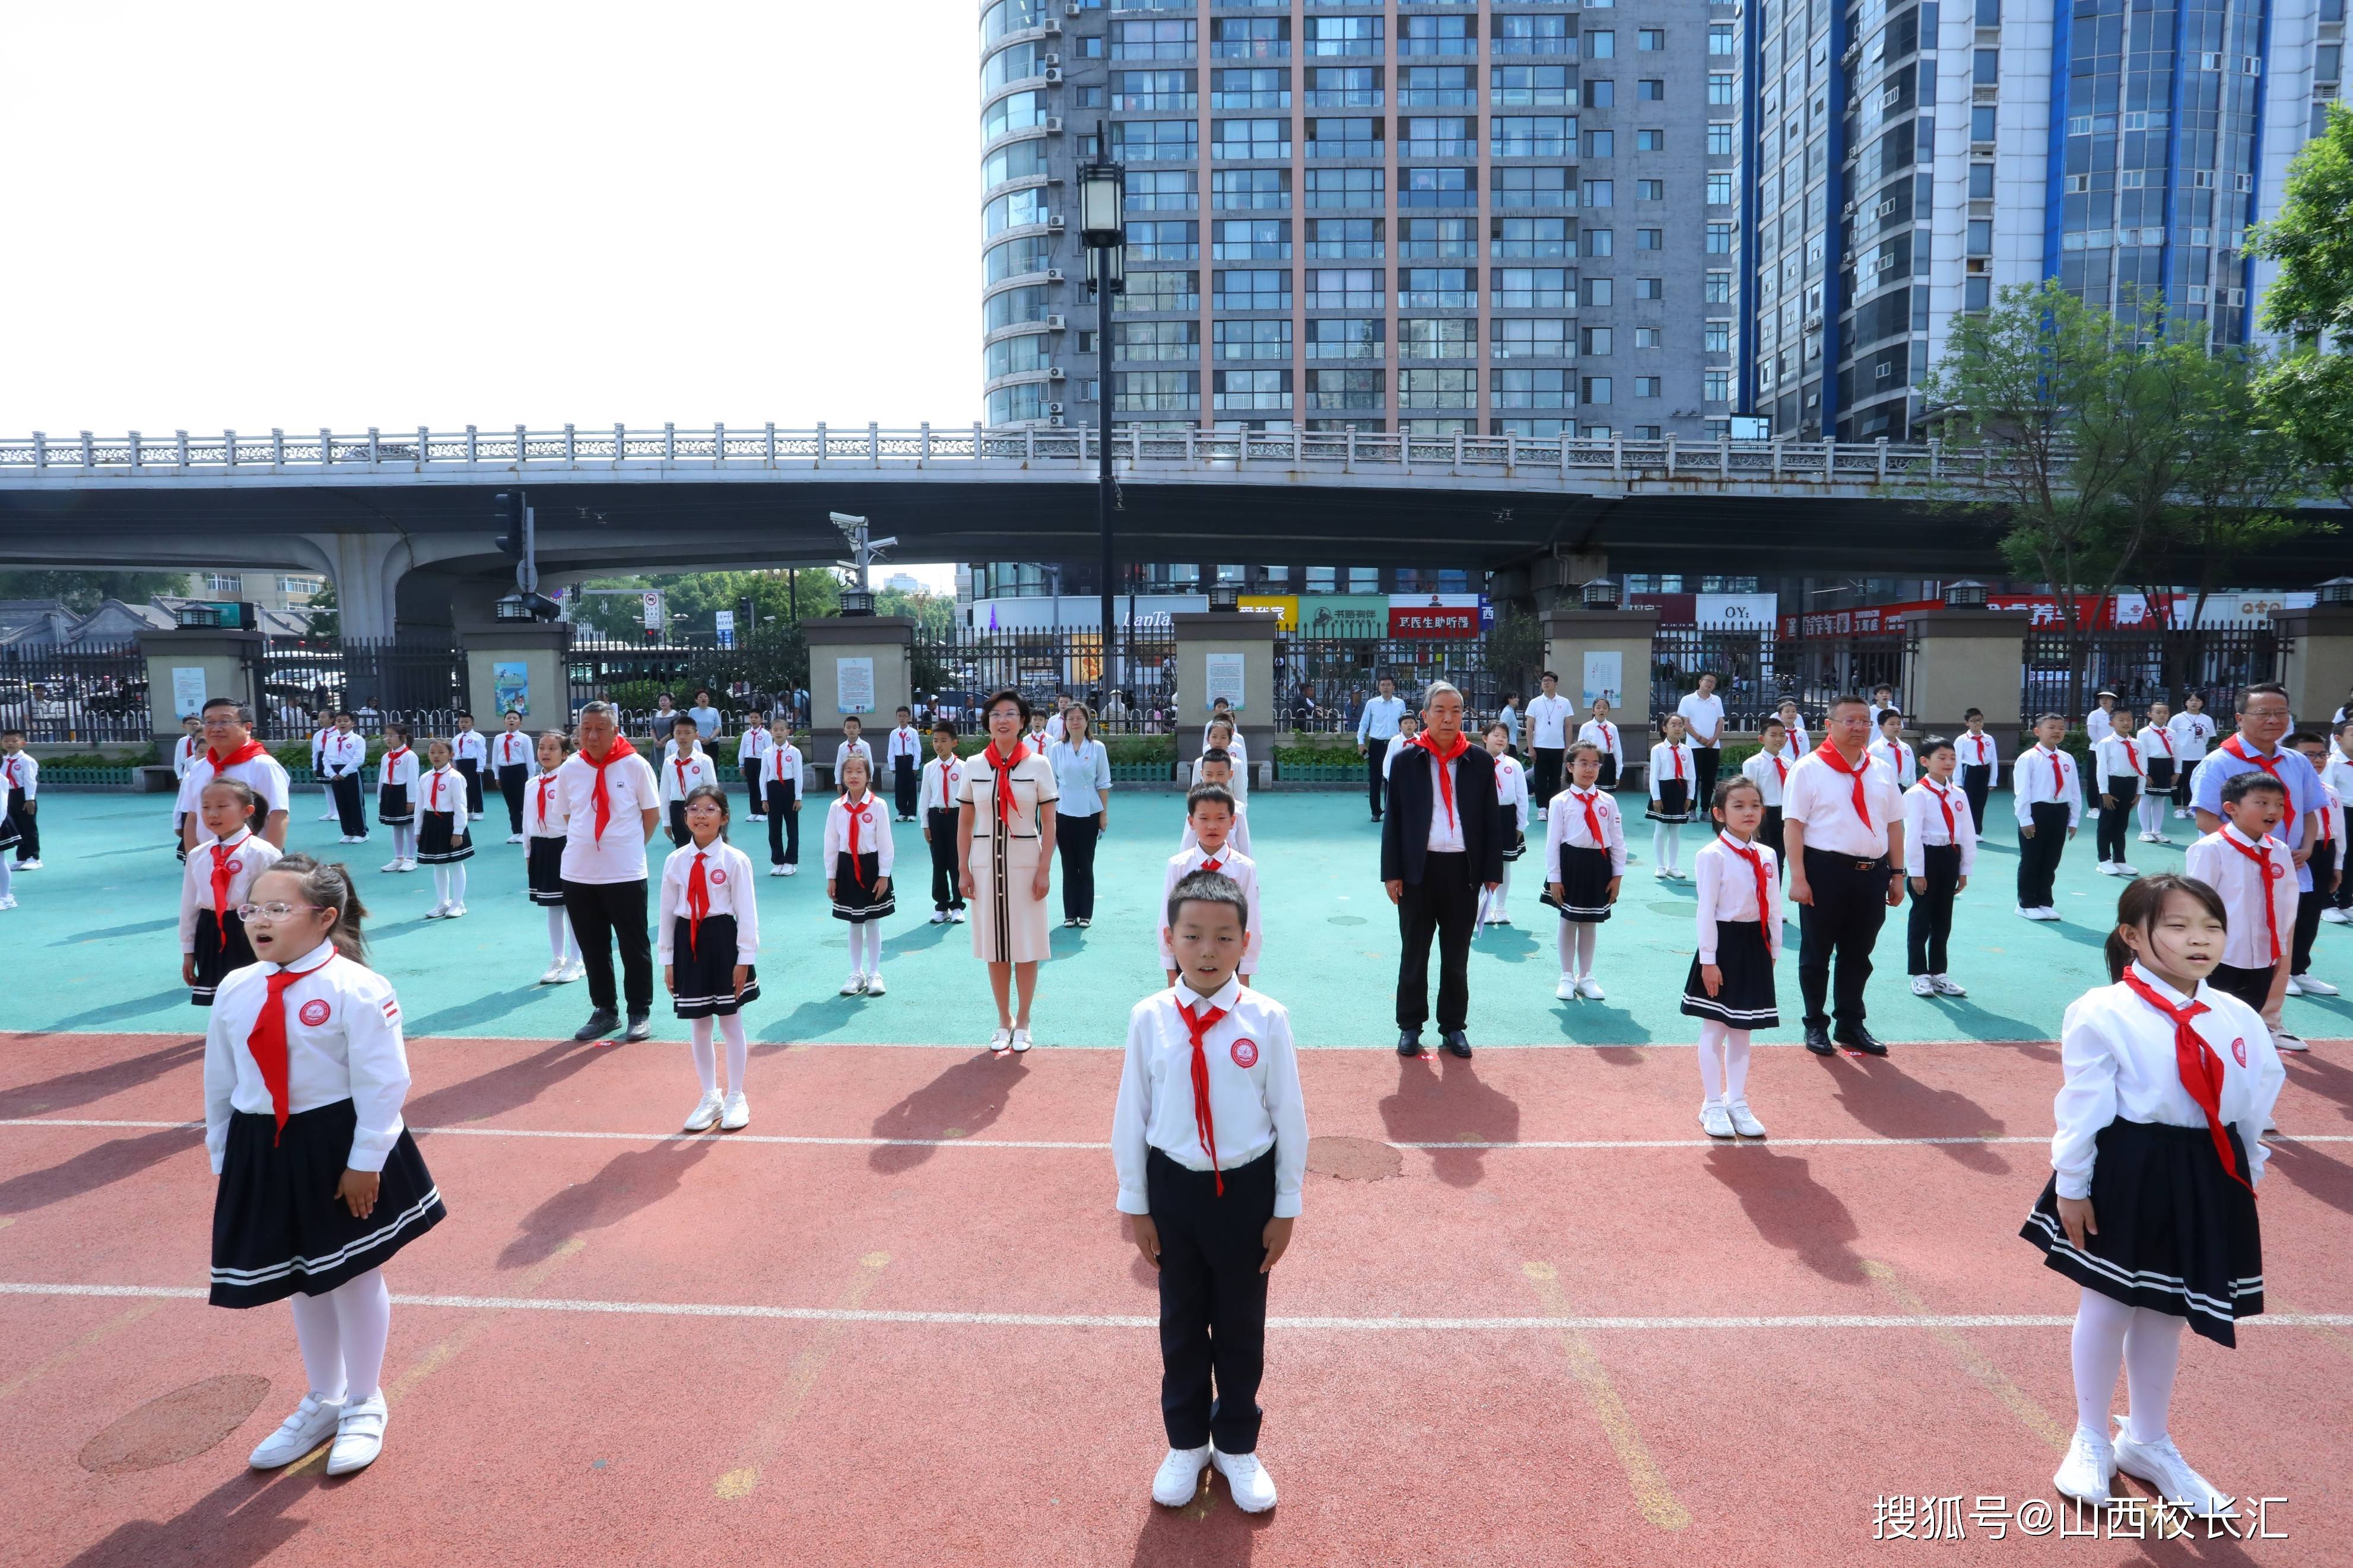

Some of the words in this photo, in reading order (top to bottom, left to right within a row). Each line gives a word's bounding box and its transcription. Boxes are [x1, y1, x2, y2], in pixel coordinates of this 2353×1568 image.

[1122, 612, 1174, 626] LanTa
[1335, 609, 1376, 618] 书路有伴
